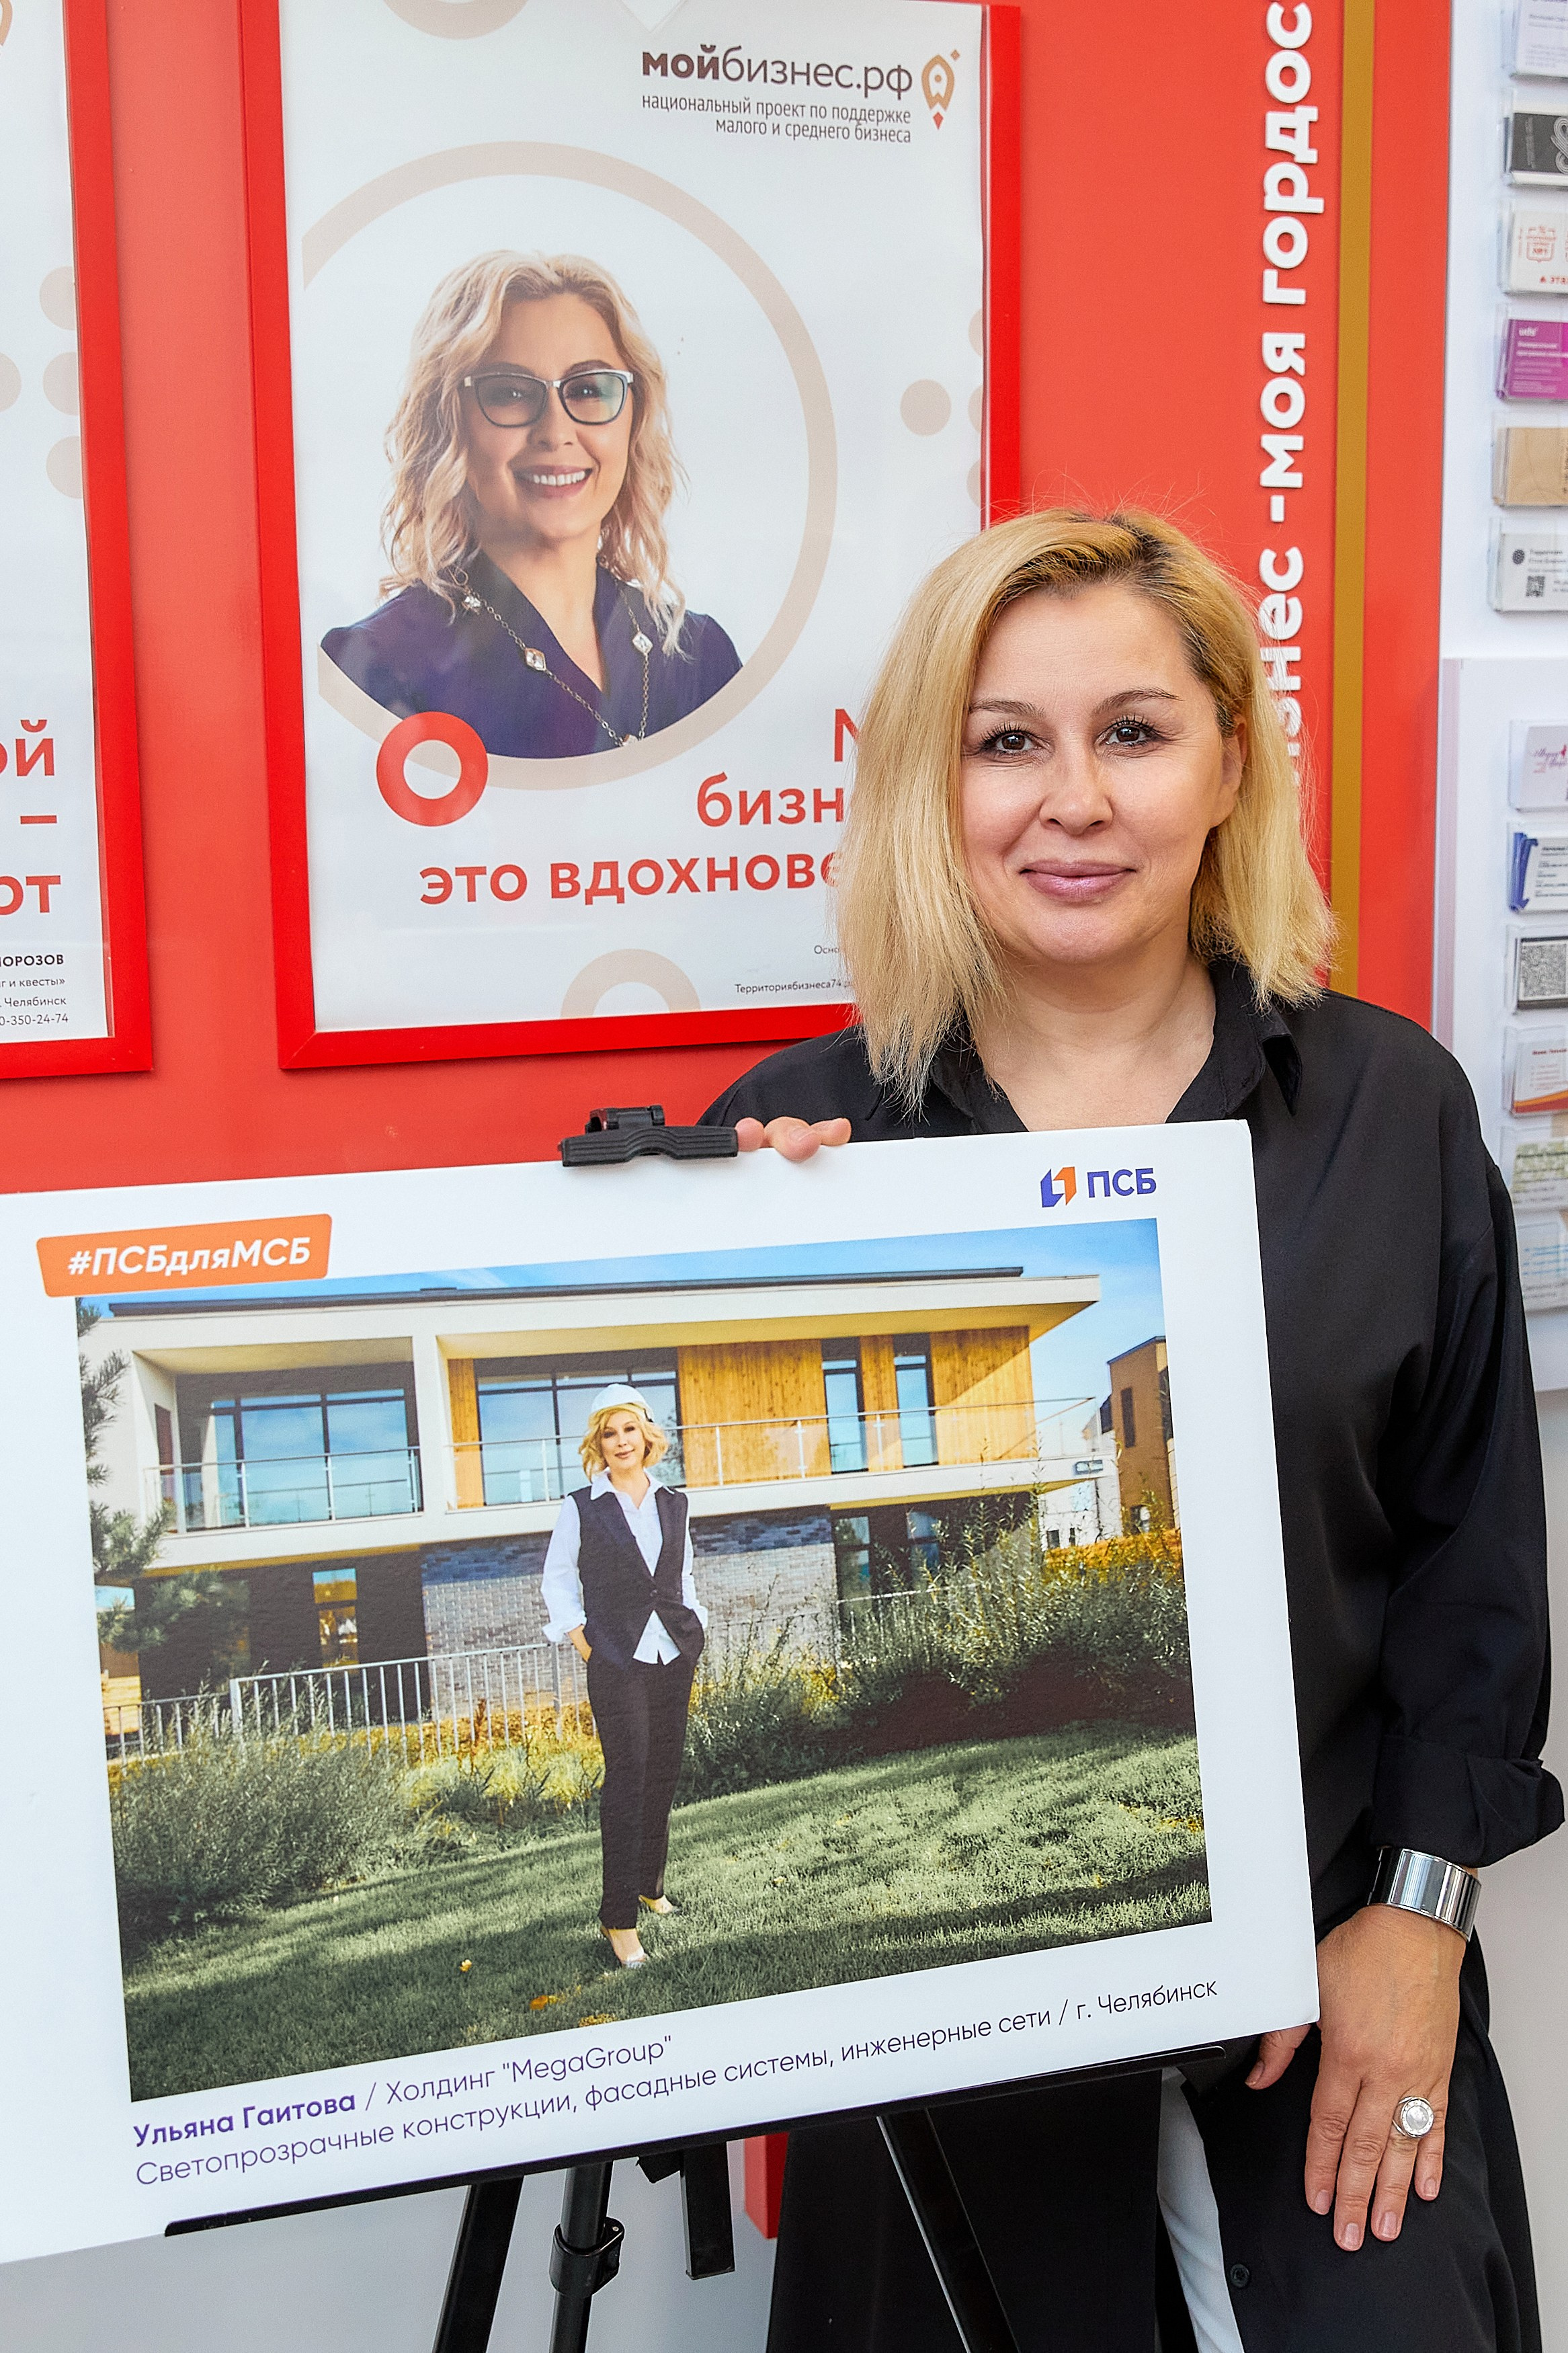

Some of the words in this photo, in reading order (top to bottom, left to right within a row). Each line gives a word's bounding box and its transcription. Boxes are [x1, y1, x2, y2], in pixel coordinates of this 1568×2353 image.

[642, 44, 913, 100] мойбизнес.рф
[642, 95, 751, 116] национальный
[756, 102, 806, 119] проект
[810, 104, 827, 119] по
[831, 106, 911, 125] поддержке
[716, 120, 768, 136] малого
[772, 124, 780, 136] и
[785, 124, 850, 141] среднего
[854, 121, 911, 144] бизнеса
[0, 719, 55, 777] й
[421, 865, 528, 905] это
[0, 954, 65, 967] ОРОЗОВ
[19, 978, 65, 987] квесты»
[5, 996, 67, 1007] Челябинск
[1087, 1167, 1157, 1198] ПСБ
[67, 1237, 311, 1276] #ПСБдляМСБ
[133, 2114, 235, 2147] Ульяна
[243, 2093, 356, 2128] Гаитова
[386, 2069, 496, 2106] Холдинг
[502, 2035, 672, 2084] "MegaGroup"
[136, 2126, 395, 2185] Светопрозрачные
[402, 2093, 578, 2139] конструкции,
[585, 2069, 717, 2112] фасадные
[724, 2048, 834, 2081] системы,
[841, 2021, 992, 2062] инженерные
[998, 2007, 1051, 2033] сети
[1077, 2003, 1093, 2021] г.
[1098, 1979, 1219, 2016] Челябинск
